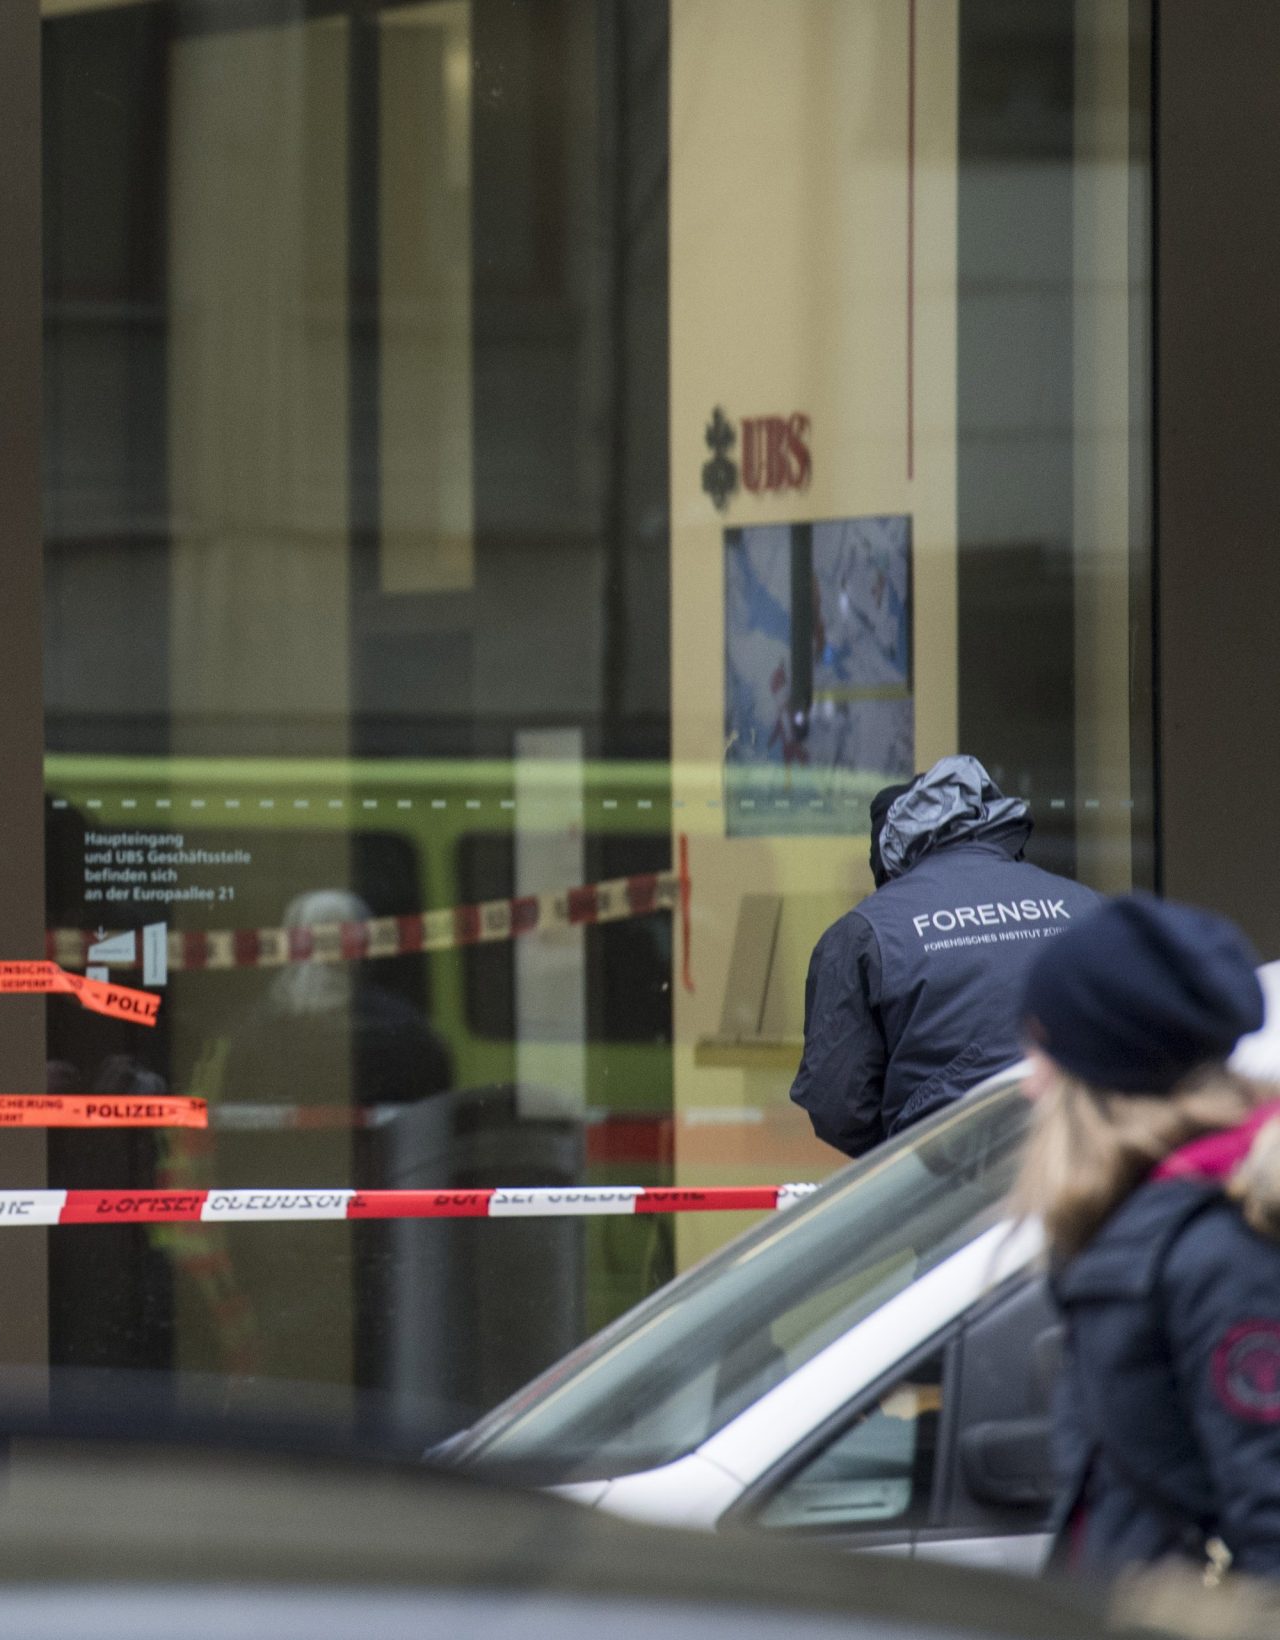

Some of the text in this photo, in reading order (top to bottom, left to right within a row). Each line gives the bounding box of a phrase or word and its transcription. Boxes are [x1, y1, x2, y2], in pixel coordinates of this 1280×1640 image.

[740, 411, 812, 494] UBS
[84, 832, 184, 848] Haupteingang
[84, 850, 251, 864] und UBS Geschäftsstelle
[84, 868, 177, 882] befinden sich
[84, 886, 234, 903] an der Europaallee 21
[913, 899, 1071, 937] FORENSIK
[923, 933, 998, 952] FORENSISCHES
[999, 928, 1041, 941] INSTITUT
[1, 979, 54, 989] GESPERRT
[86, 1104, 164, 1118] POLIZEI
